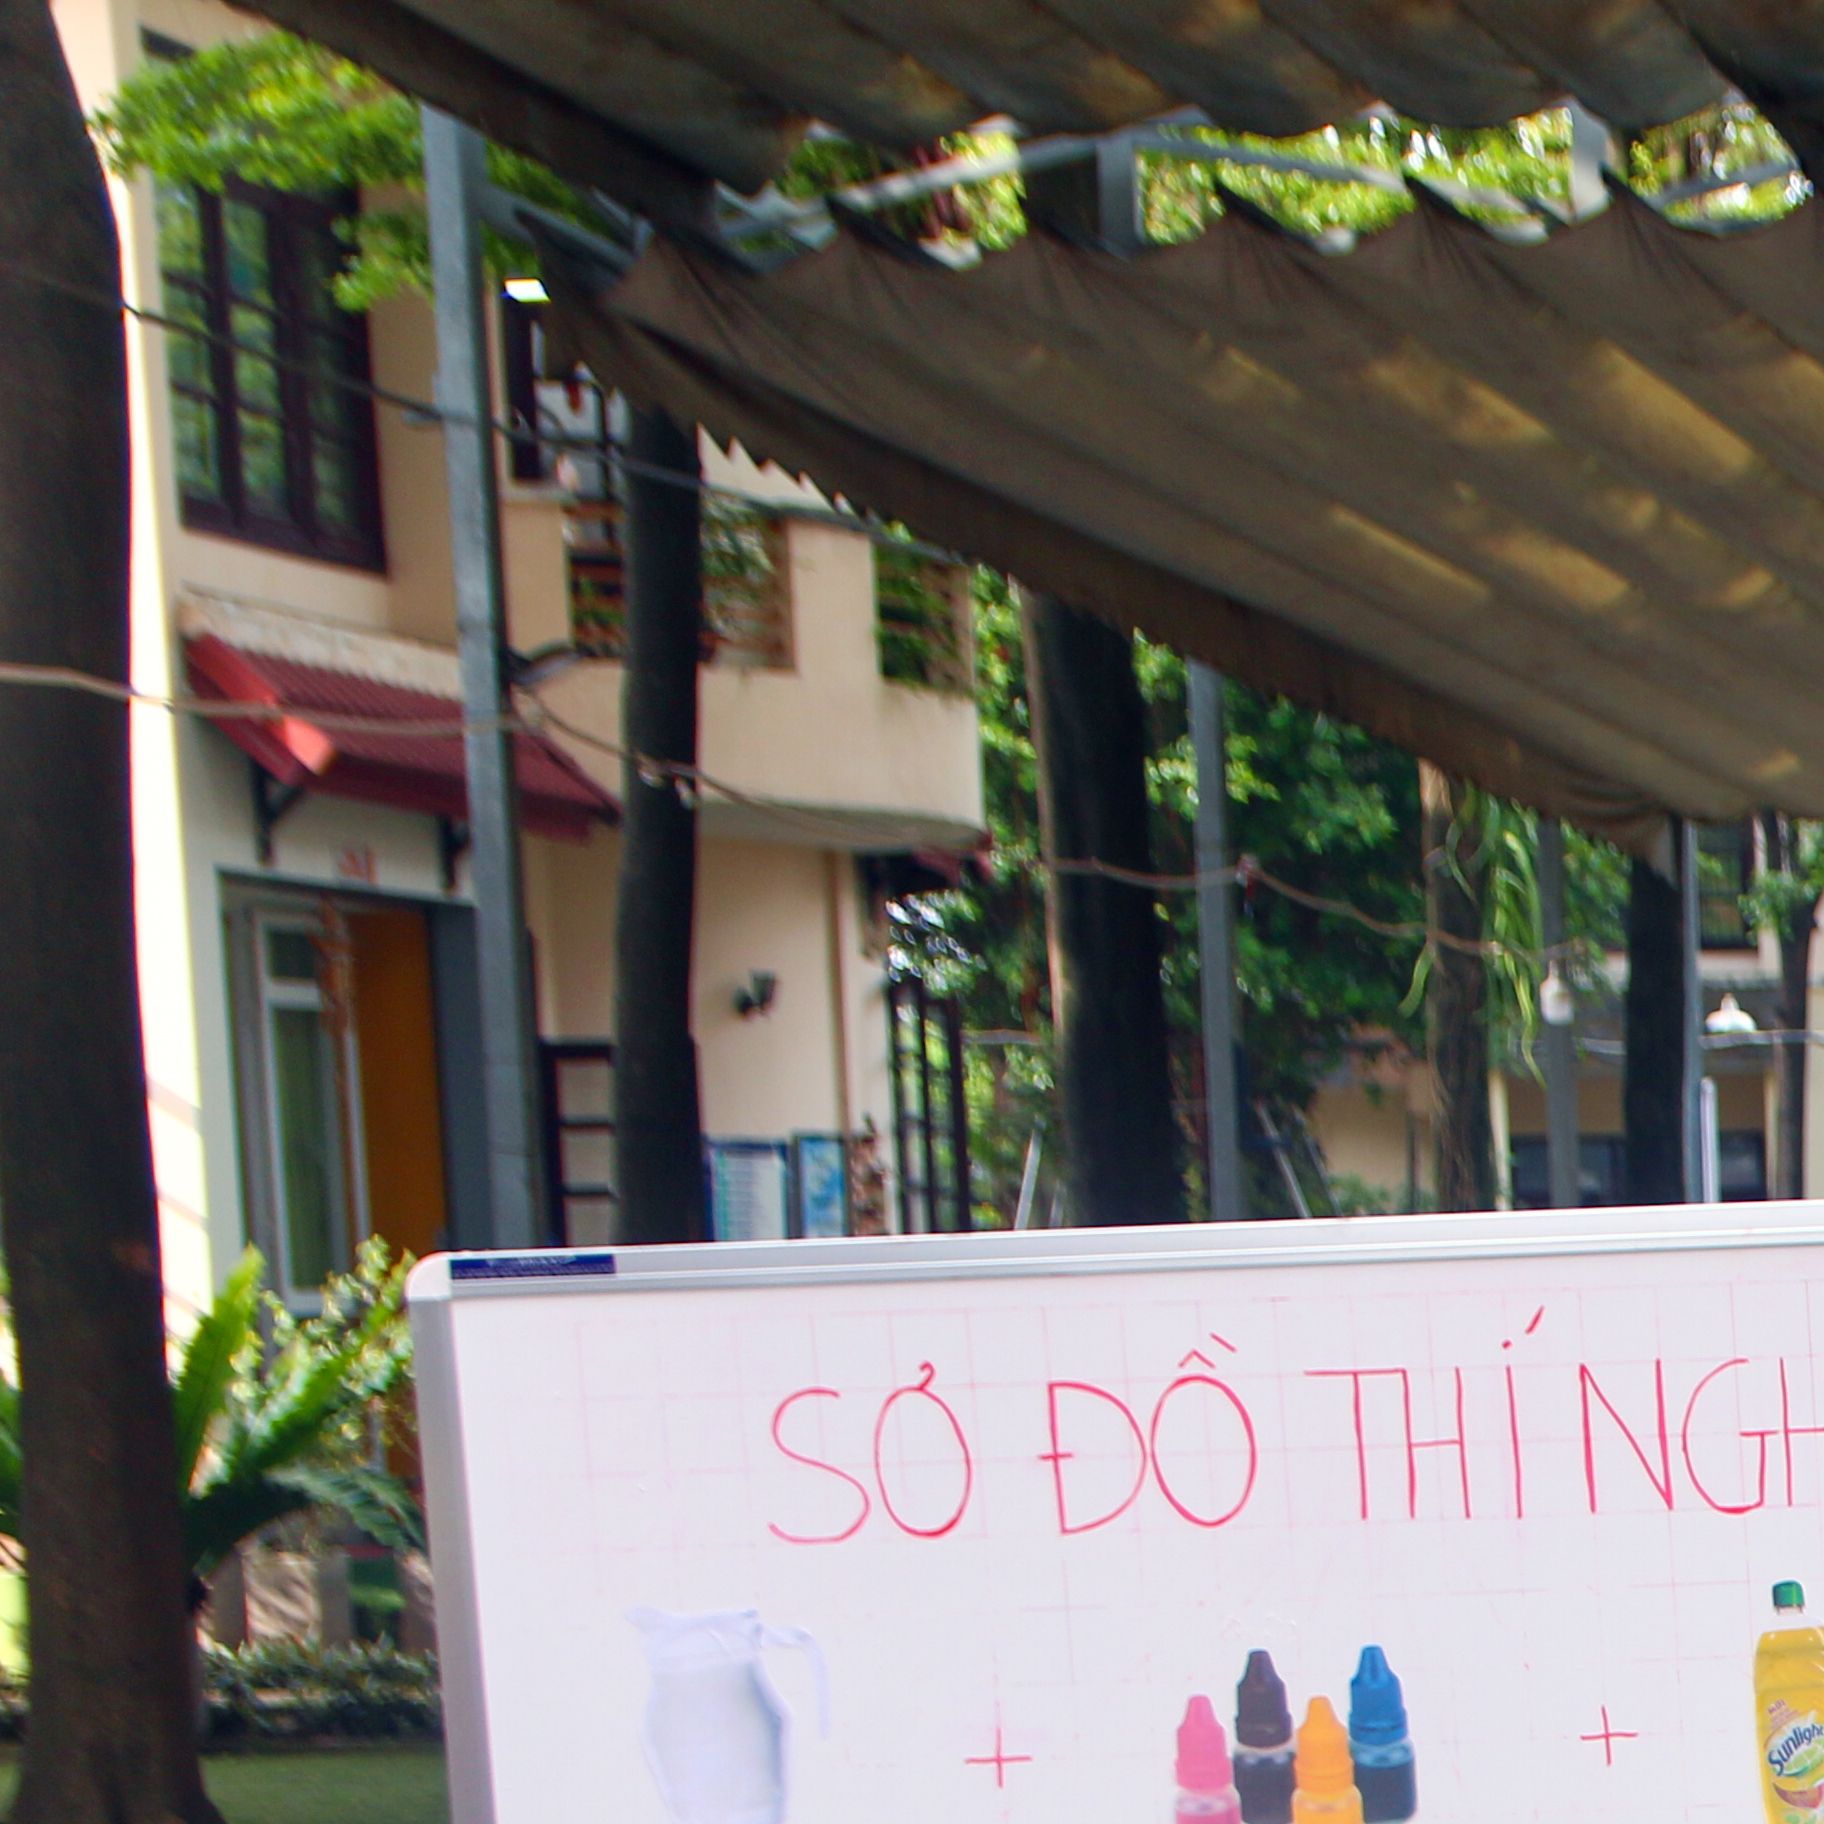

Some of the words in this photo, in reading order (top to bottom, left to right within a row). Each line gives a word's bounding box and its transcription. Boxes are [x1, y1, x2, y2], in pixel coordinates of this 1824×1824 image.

[1037, 1332, 1260, 1537] ĐỒ
[1304, 1305, 1546, 1521] THÍ
[1767, 1722, 1824, 1777] Sunlight
